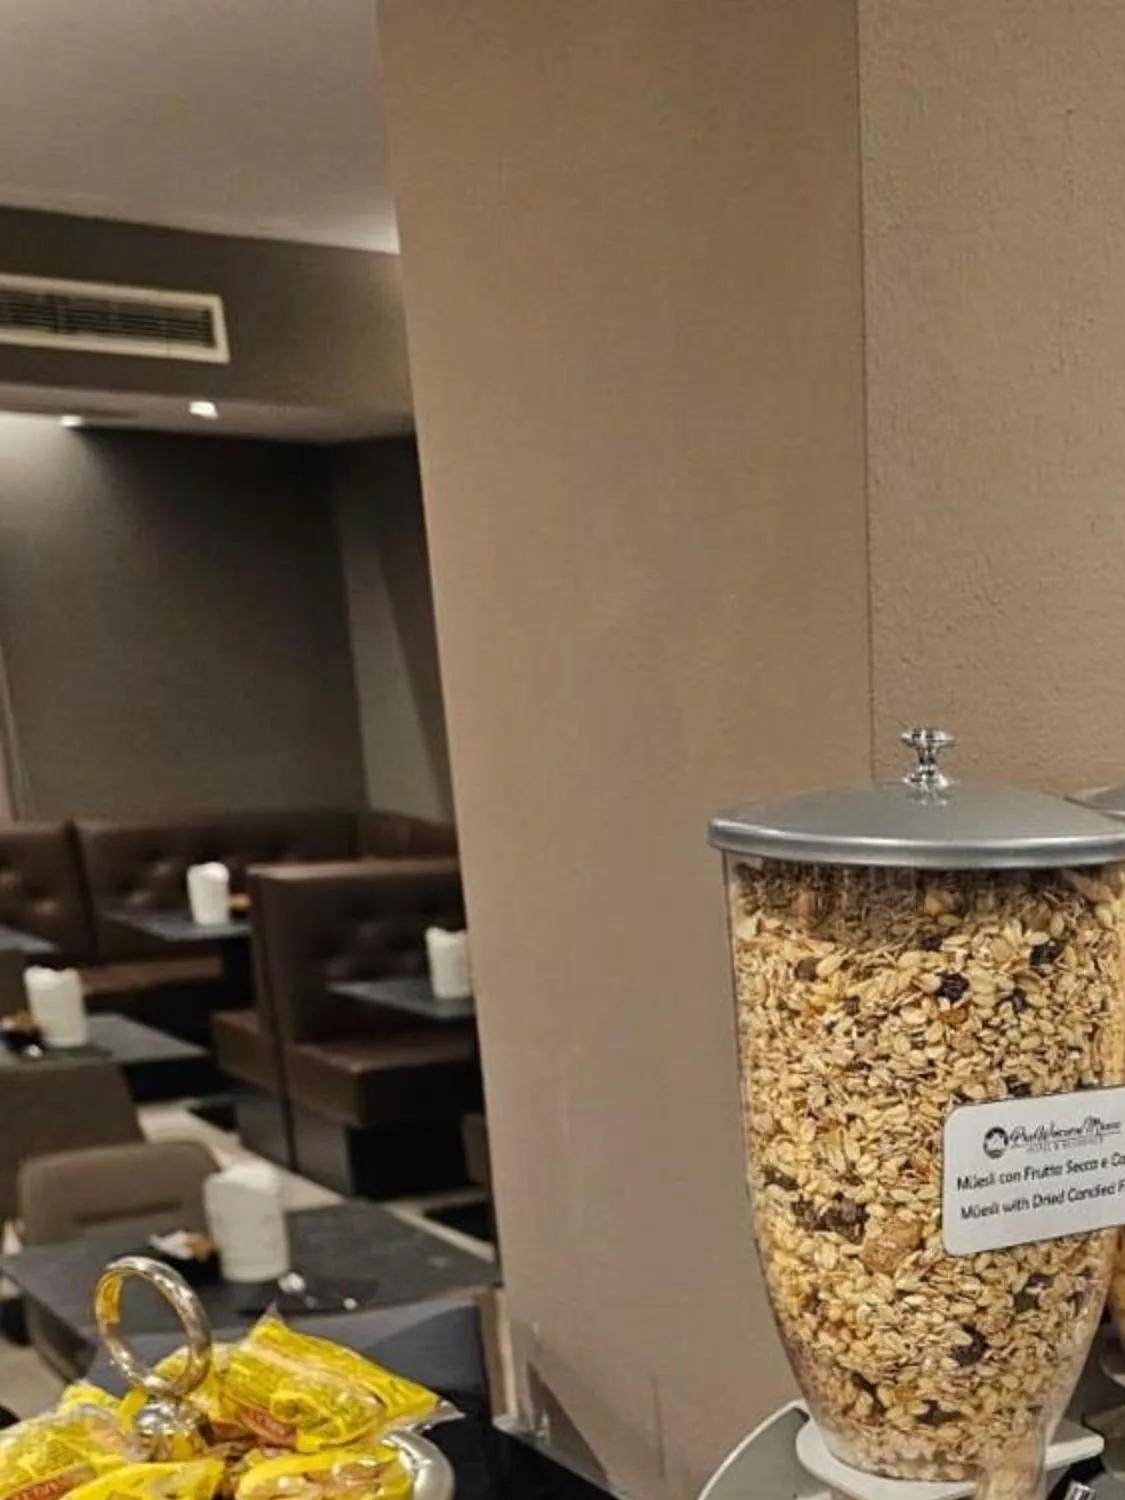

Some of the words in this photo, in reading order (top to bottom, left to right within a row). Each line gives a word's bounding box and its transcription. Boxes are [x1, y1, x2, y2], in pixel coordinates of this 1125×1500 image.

[1000, 1170, 1021, 1184] con
[1066, 1158, 1098, 1176] Secca
[1002, 1198, 1030, 1213] with
[1032, 1189, 1065, 1209] Dried
